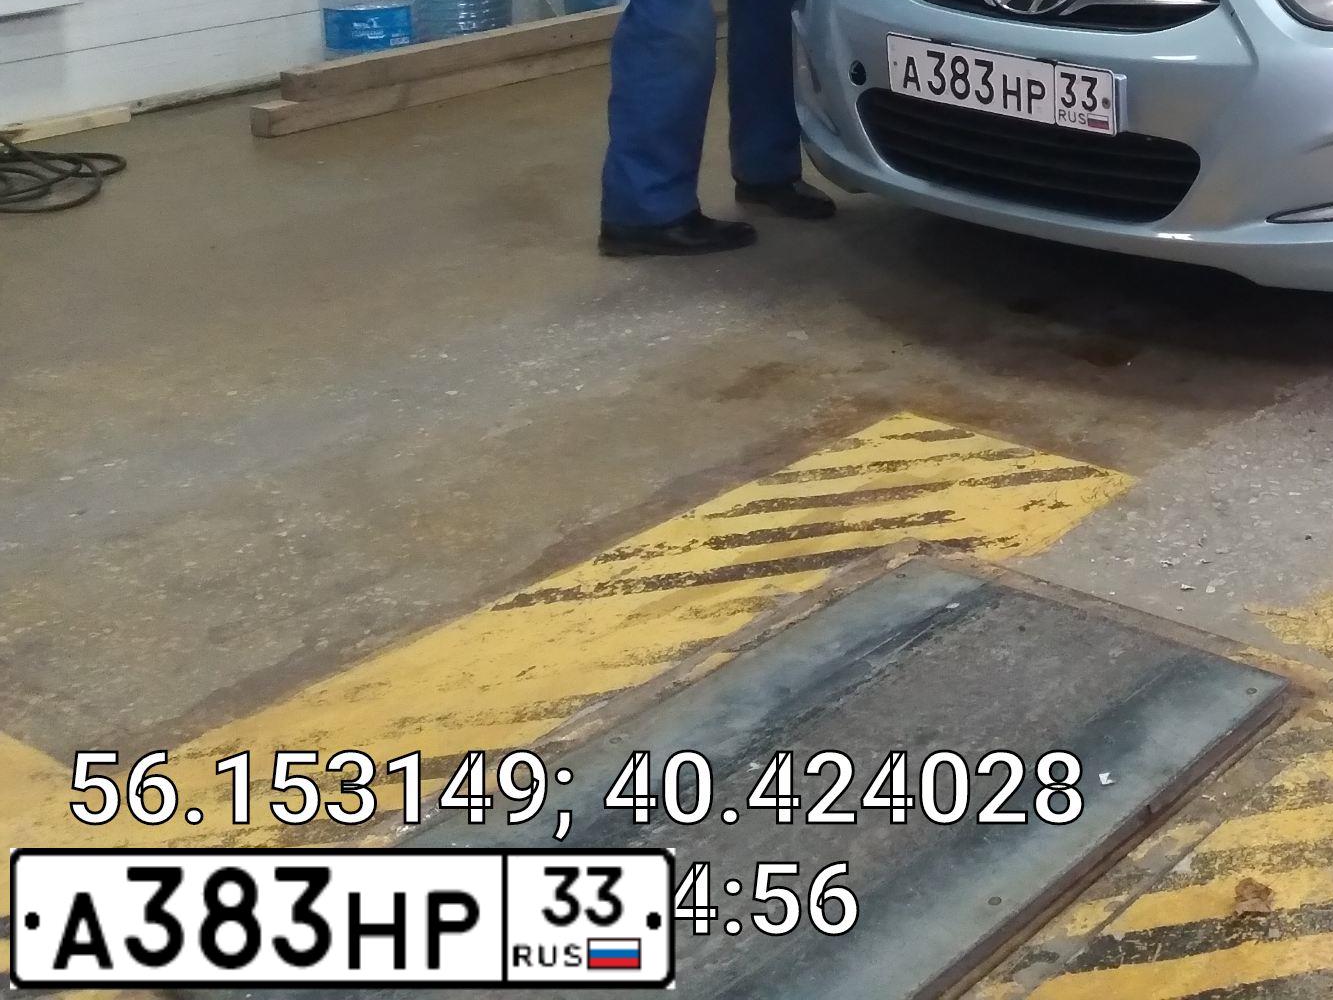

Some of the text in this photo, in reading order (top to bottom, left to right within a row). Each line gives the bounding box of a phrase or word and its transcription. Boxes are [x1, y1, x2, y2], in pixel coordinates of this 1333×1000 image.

[903, 50, 1046, 114] А383НР
[1060, 72, 1098, 112] 33
[1058, 109, 1087, 125] RUS
